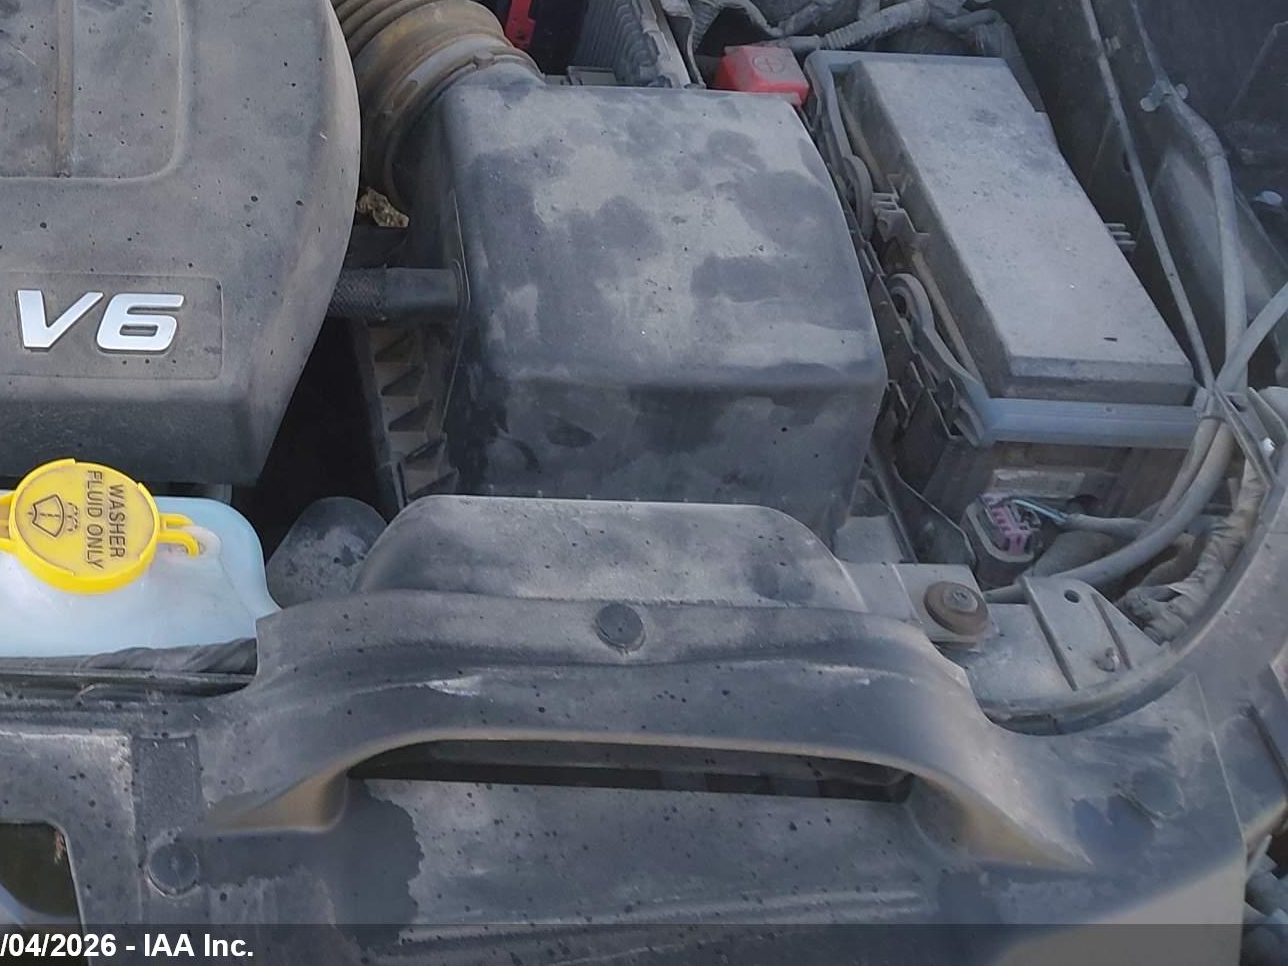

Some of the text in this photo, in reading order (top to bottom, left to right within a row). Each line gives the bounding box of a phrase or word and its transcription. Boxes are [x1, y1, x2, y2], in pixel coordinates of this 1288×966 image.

[15, 289, 185, 353] V6
[85, 469, 105, 570] FLUID ONLY
[108, 483, 126, 559] WASHER
